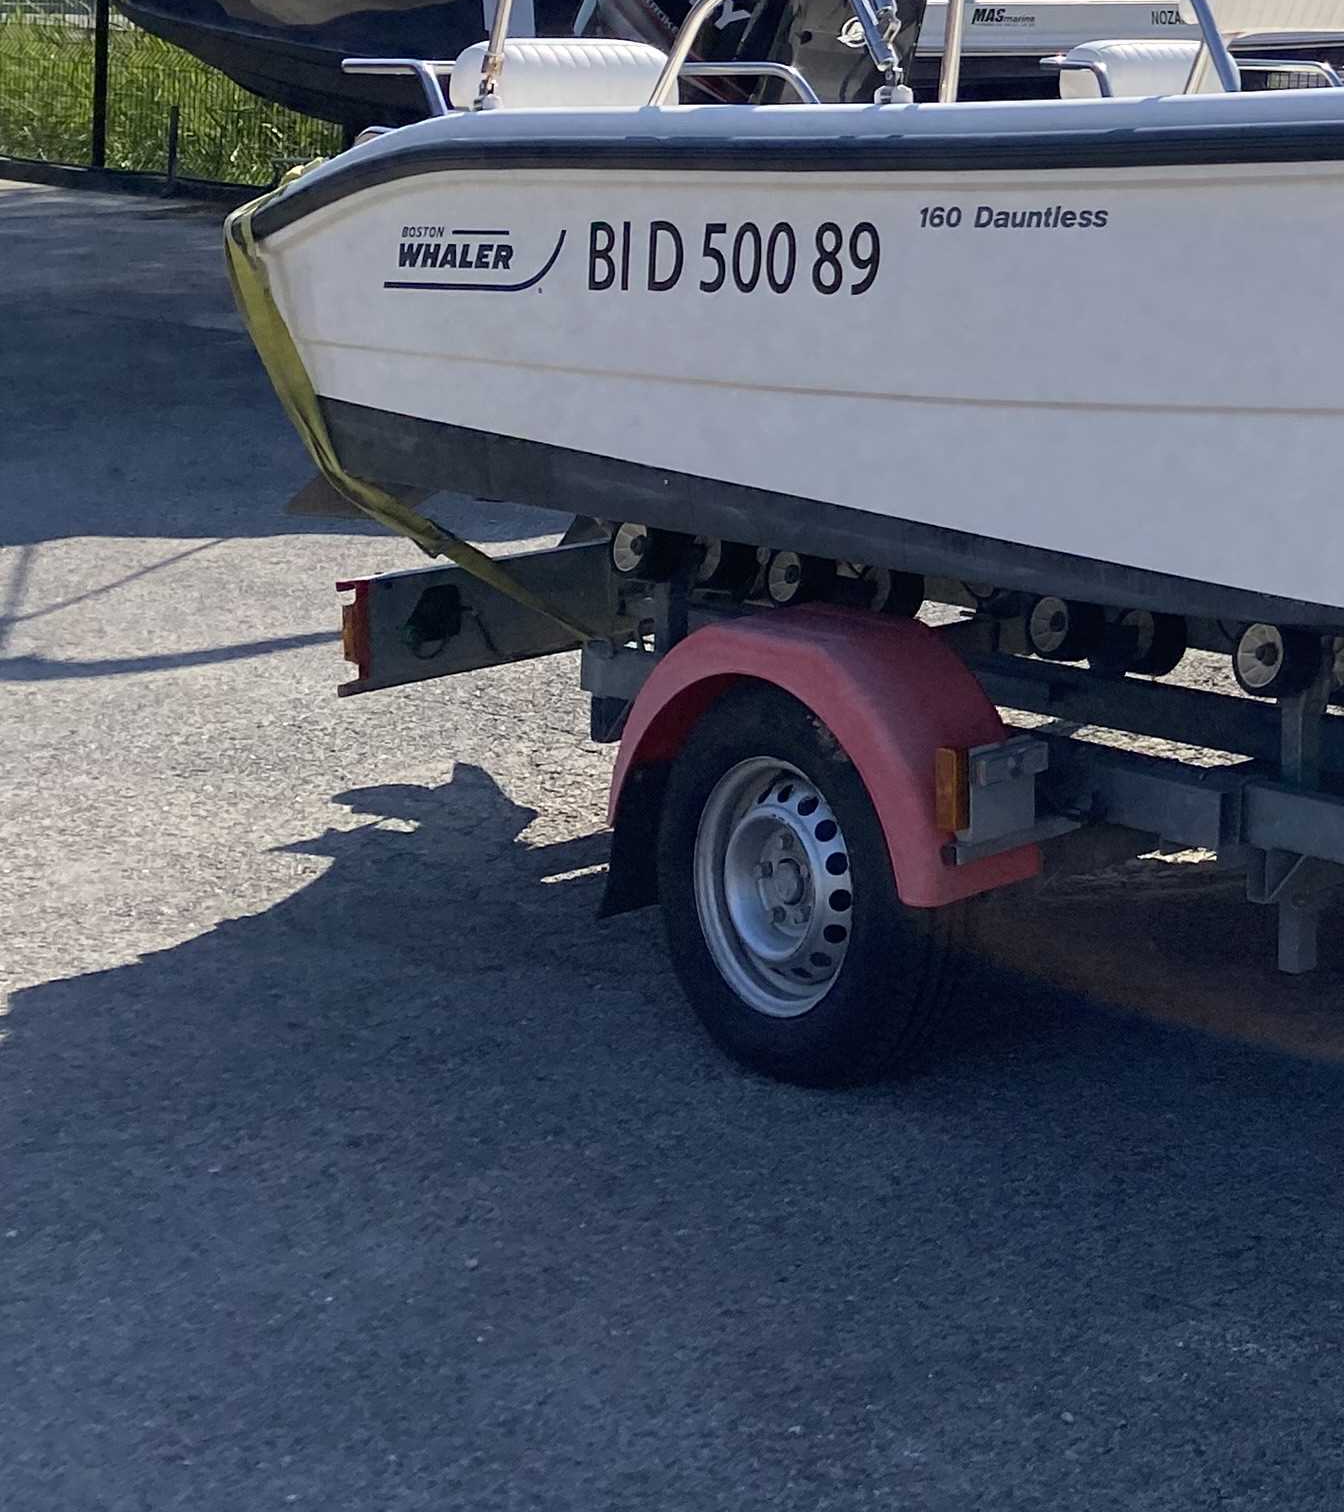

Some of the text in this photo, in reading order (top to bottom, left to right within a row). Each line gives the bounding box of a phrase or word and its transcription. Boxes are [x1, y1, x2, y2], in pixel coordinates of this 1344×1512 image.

[1151, 9, 1188, 26] NOZA
[919, 205, 1109, 229] 160 Dauntless
[401, 225, 445, 238] BOSTON
[398, 242, 514, 270] WHALER
